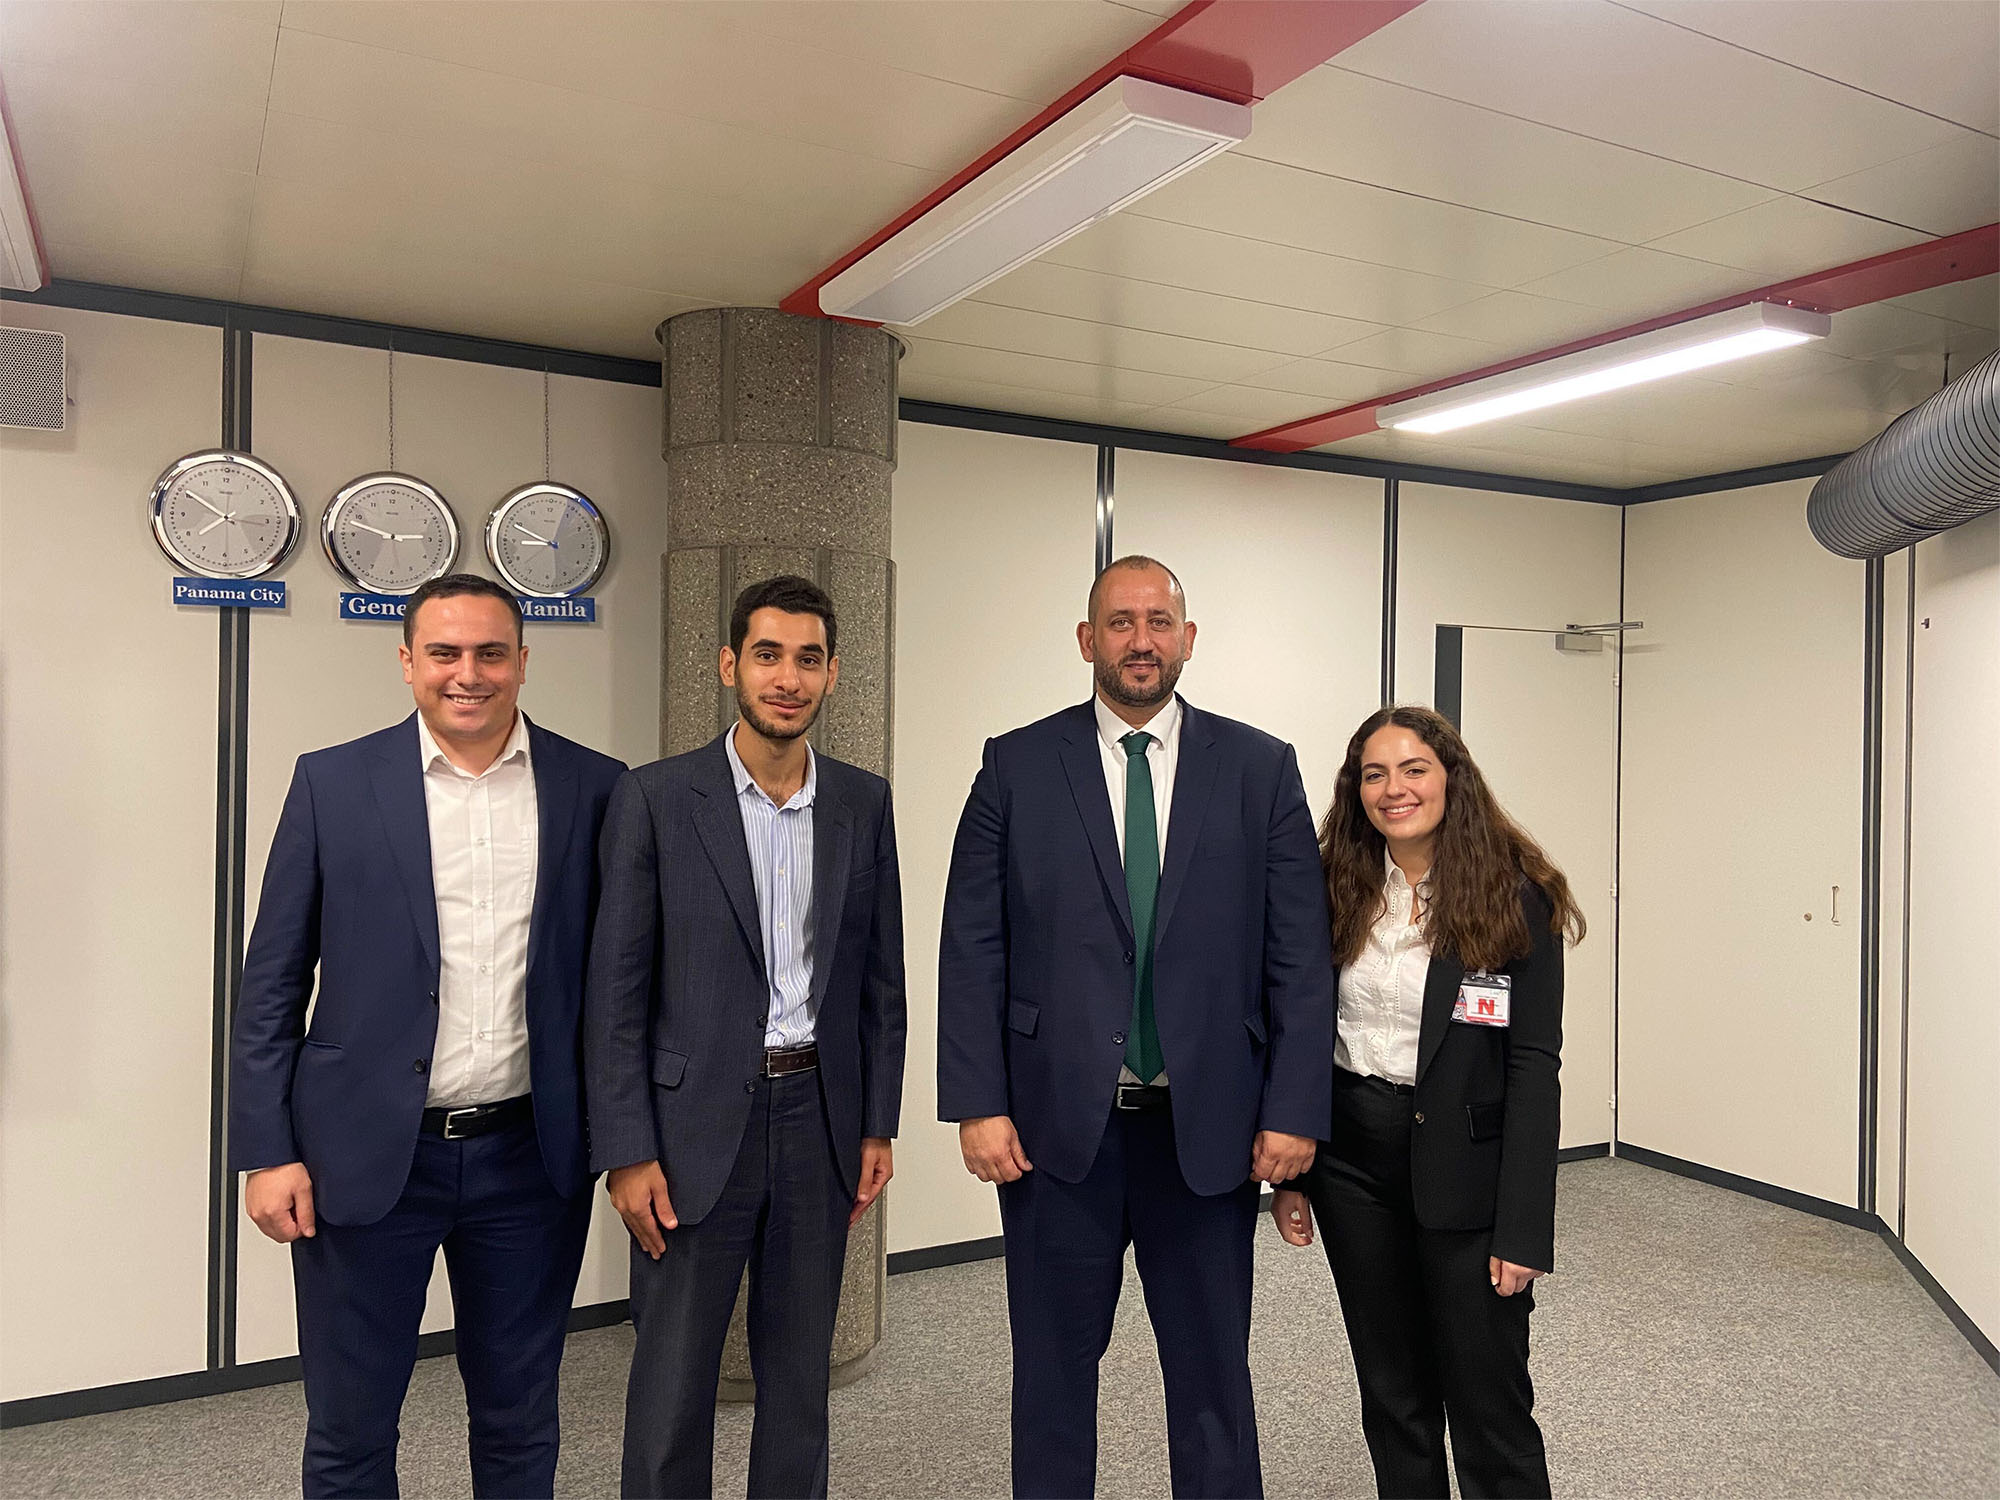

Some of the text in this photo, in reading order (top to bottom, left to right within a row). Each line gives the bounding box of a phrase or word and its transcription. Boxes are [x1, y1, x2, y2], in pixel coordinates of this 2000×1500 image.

[175, 585, 284, 604] Panama City
[348, 597, 407, 616] Gene
[517, 600, 587, 617] Manila
[1478, 998, 1495, 1016] N
